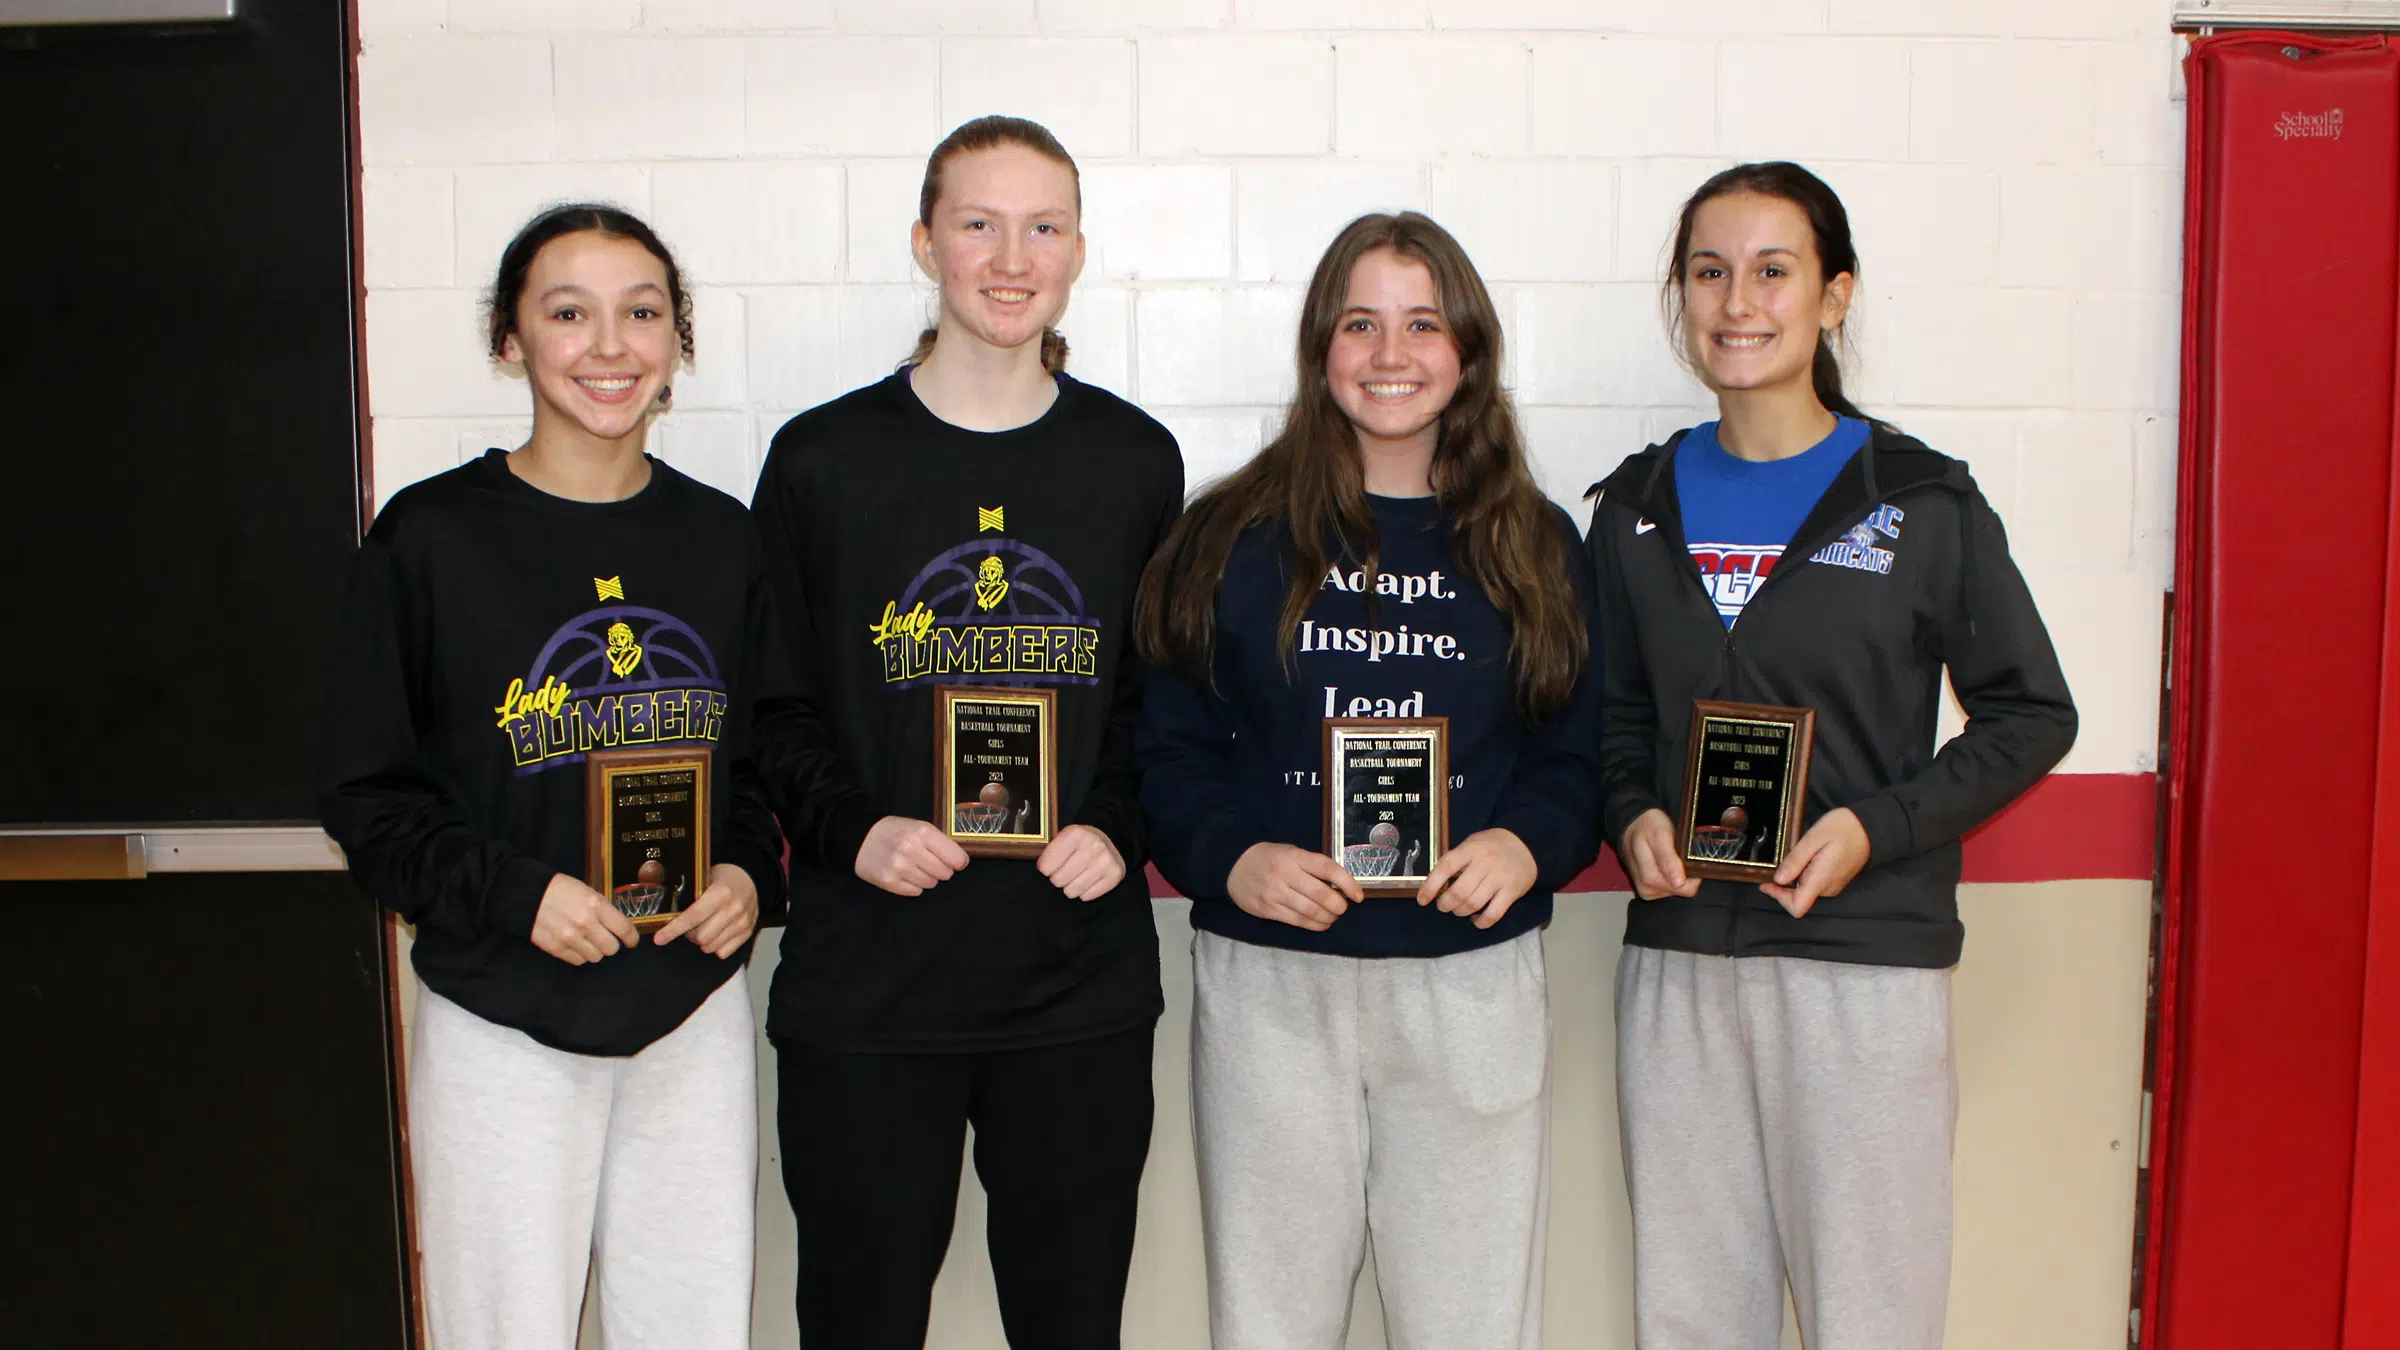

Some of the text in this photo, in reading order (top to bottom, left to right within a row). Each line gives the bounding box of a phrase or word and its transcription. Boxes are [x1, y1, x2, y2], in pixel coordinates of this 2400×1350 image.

[2281, 111, 2328, 126] School
[2274, 122, 2342, 141] Specialty
[1320, 565, 1457, 604] Adapt.
[869, 600, 936, 645] Lady
[1300, 620, 1466, 662] Inspire.
[494, 675, 571, 728] Lady
[956, 705, 1036, 717] NATIONAL TRAIL CONFERENCE
[960, 722, 1031, 733] BASKETBALL TOURNAMENT
[988, 739, 1004, 748] GIRLS
[1345, 740, 1427, 750] NATIONAL TRAIL CONFERENCE
[963, 754, 1029, 766] ALL-TOURNAMENT TEAM
[1350, 758, 1422, 768] BASKETBALL TOURNAMENT
[988, 772, 1004, 781] 2023
[1378, 775, 1395, 785] GIRLS
[1353, 793, 1420, 803] ALL-TOURNAMENT TEAM
[1378, 810, 1394, 821] 2023
